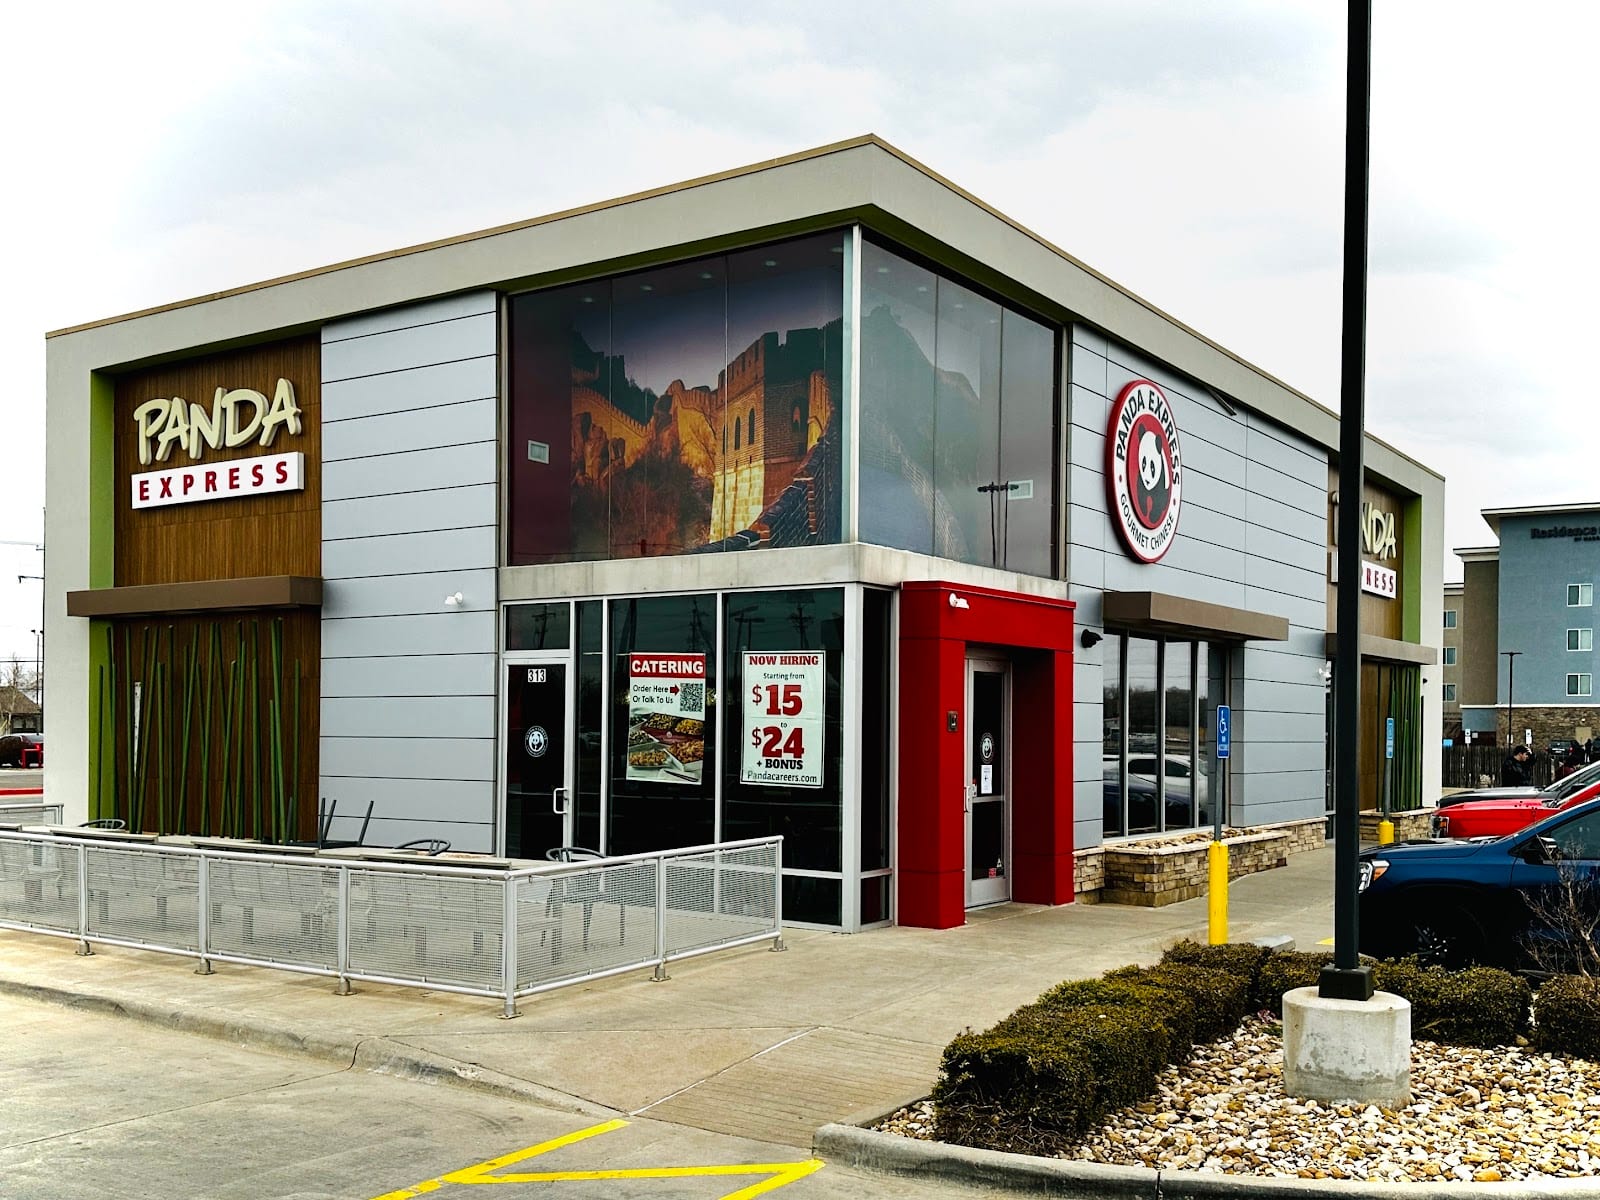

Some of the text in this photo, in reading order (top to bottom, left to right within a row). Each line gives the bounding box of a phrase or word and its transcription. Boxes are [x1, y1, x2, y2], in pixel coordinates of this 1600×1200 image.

[133, 377, 302, 466] PANDA
[1116, 389, 1180, 486] PANDA EXPRESS
[139, 461, 288, 501] EXPRESS
[1120, 493, 1174, 550] GOURMET CHINESE
[1361, 566, 1395, 593] RESS
[631, 660, 704, 674] CATERING
[749, 655, 819, 666] NOW HIRING
[528, 669, 546, 682] 313
[763, 672, 805, 681] Starting from
[632, 684, 669, 693] Order Here
[632, 695, 674, 704] Or Talk To Us
[752, 683, 803, 717] $15
[752, 726, 805, 759] $24
[764, 759, 804, 770] BONUS
[747, 770, 817, 783] Pandacareers.com
